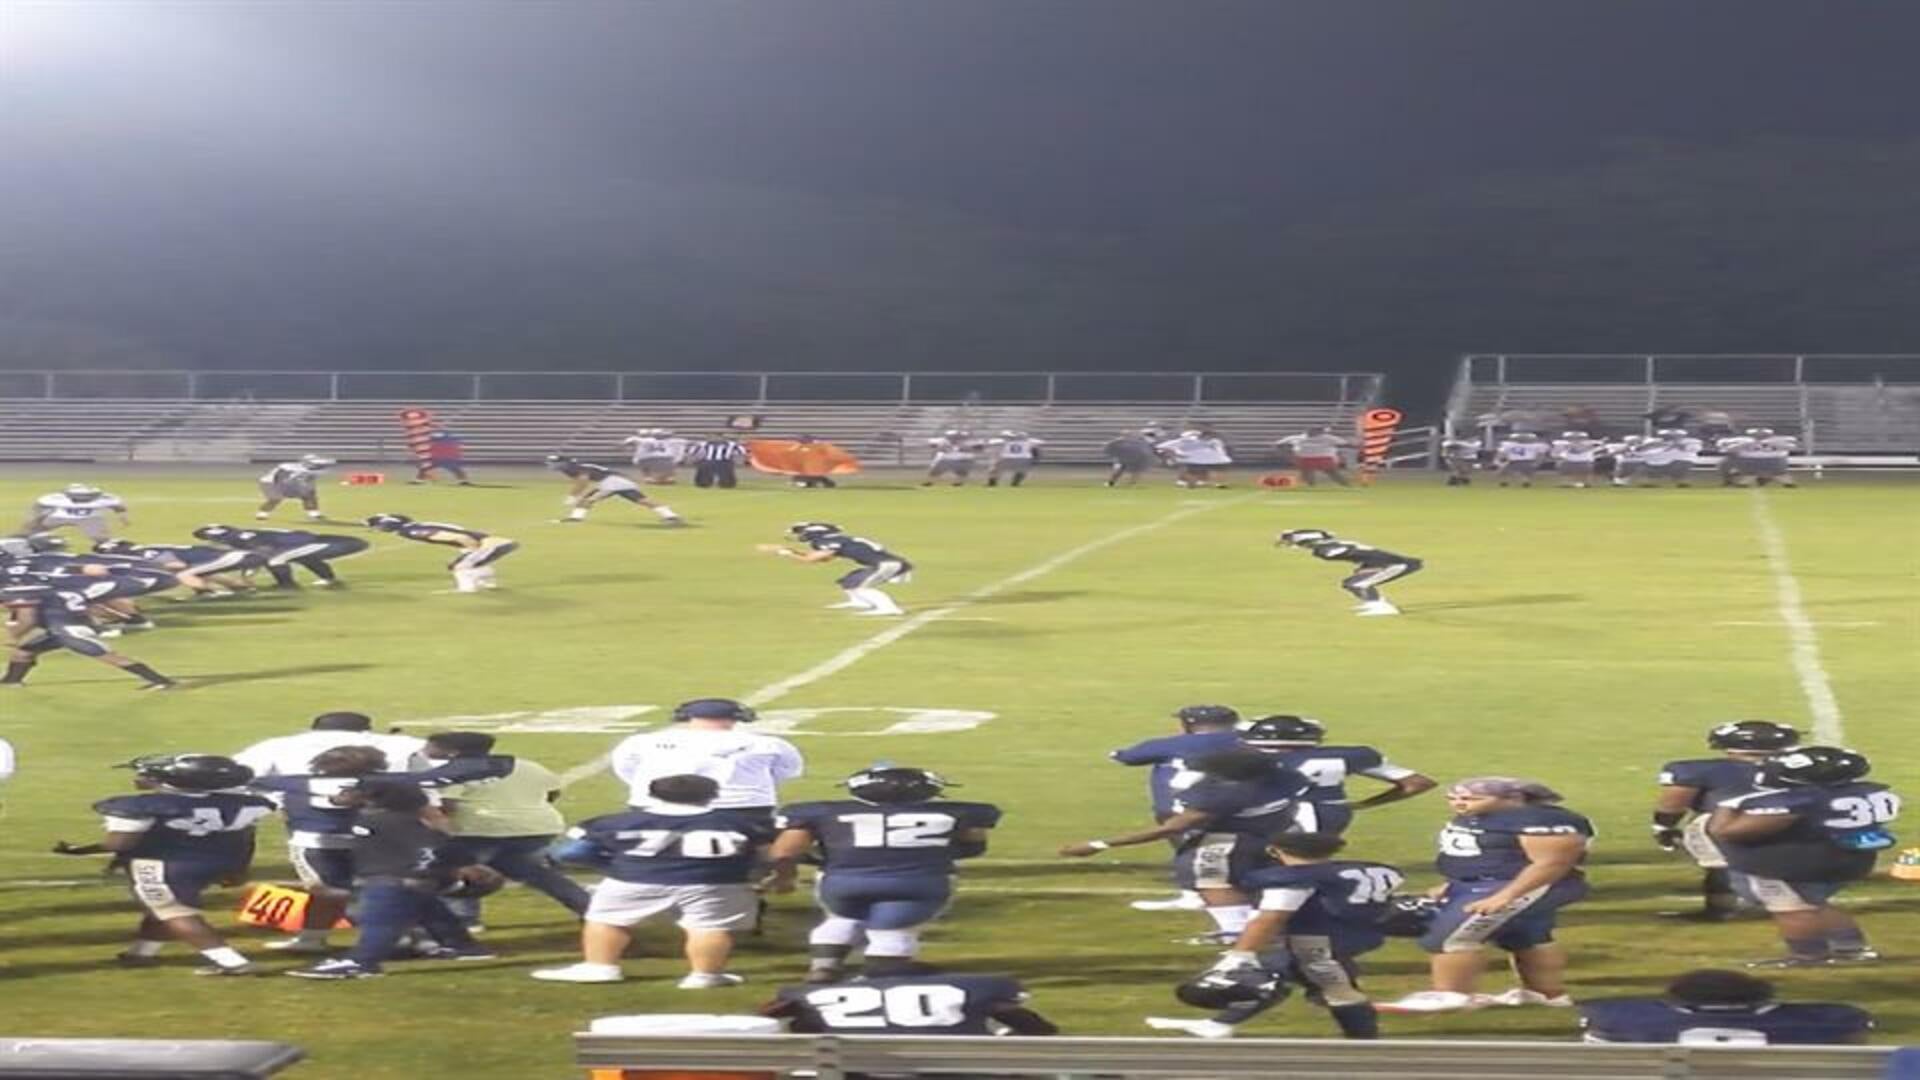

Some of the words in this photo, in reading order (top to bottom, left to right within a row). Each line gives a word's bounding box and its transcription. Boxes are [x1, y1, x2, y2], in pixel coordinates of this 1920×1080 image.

[1823, 790, 1900, 829] 30
[614, 829, 749, 859] 70
[836, 812, 957, 848] 12
[246, 889, 295, 925] 40
[804, 984, 967, 1028] 20
